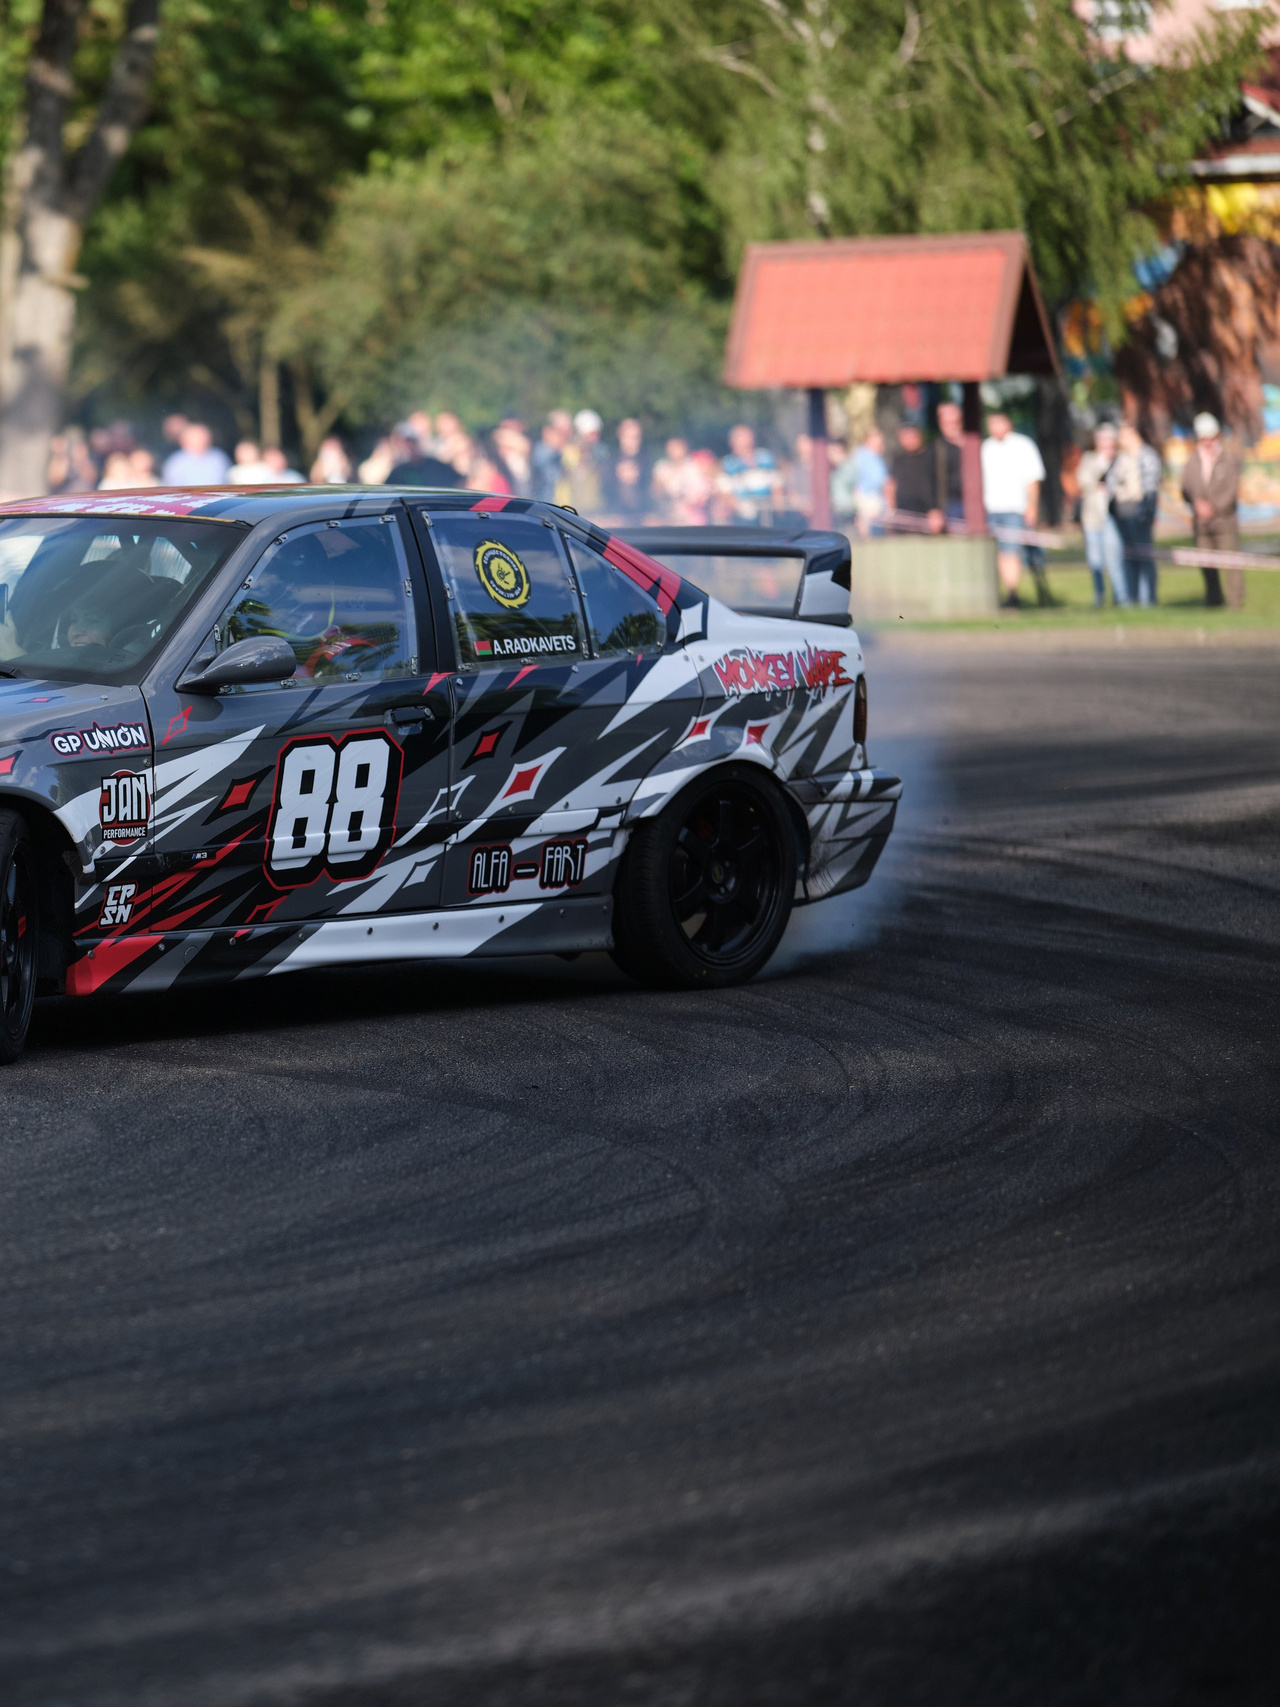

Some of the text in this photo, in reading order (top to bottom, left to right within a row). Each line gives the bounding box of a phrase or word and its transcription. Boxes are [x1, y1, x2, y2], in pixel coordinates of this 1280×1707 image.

[493, 635, 576, 655] A.RADKAVETS
[714, 640, 854, 699] MONKEY VAPE
[54, 726, 146, 753] GP UNION
[103, 776, 147, 823] JAN
[270, 738, 390, 871] 88
[103, 827, 146, 839] PERFORMANCE
[472, 851, 509, 888] ALFA
[544, 844, 585, 883] FART
